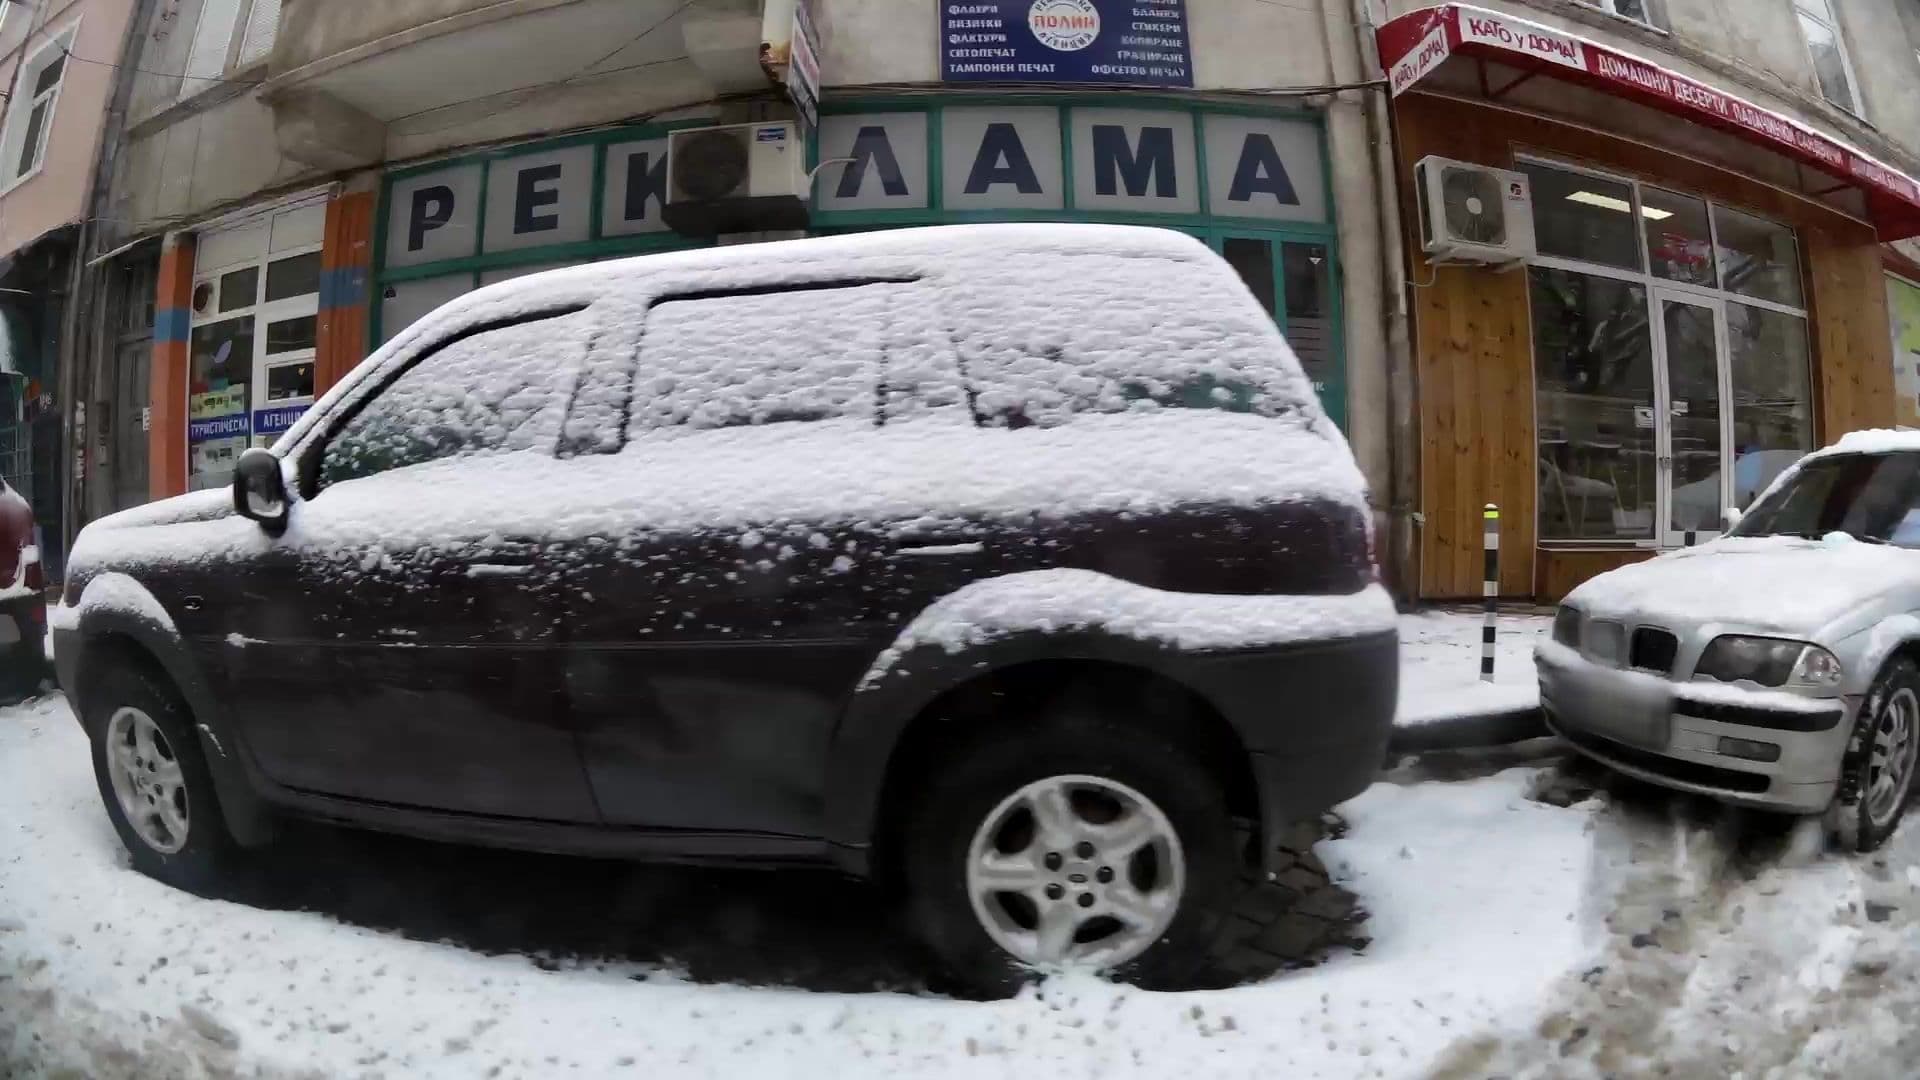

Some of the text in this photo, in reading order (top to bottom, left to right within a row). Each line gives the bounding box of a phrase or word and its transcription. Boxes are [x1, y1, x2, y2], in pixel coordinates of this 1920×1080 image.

[949, 20, 1002, 28] ВИЗИТКИ
[1034, 15, 1095, 29] ПОЛИН
[1132, 22, 1181, 32] СТИКЕРИ
[949, 34, 1007, 44] ФАКТУРИ
[1121, 36, 1183, 47] КОПИРАНЕ
[1469, 18, 1512, 43] КАТО
[1528, 33, 1577, 64] ДОМА!
[949, 49, 1016, 57] СИТОПЕЧАТ
[949, 64, 1055, 72] ТАМПОНЕН ПЕЧАТ
[1091, 64, 1146, 74] ОФСЕТОВ
[1598, 54, 1672, 95] ДОМАШНИ
[1673, 79, 1728, 115] ДЕСЕРТИ
[263, 411, 303, 427] АГЕНЦИ
